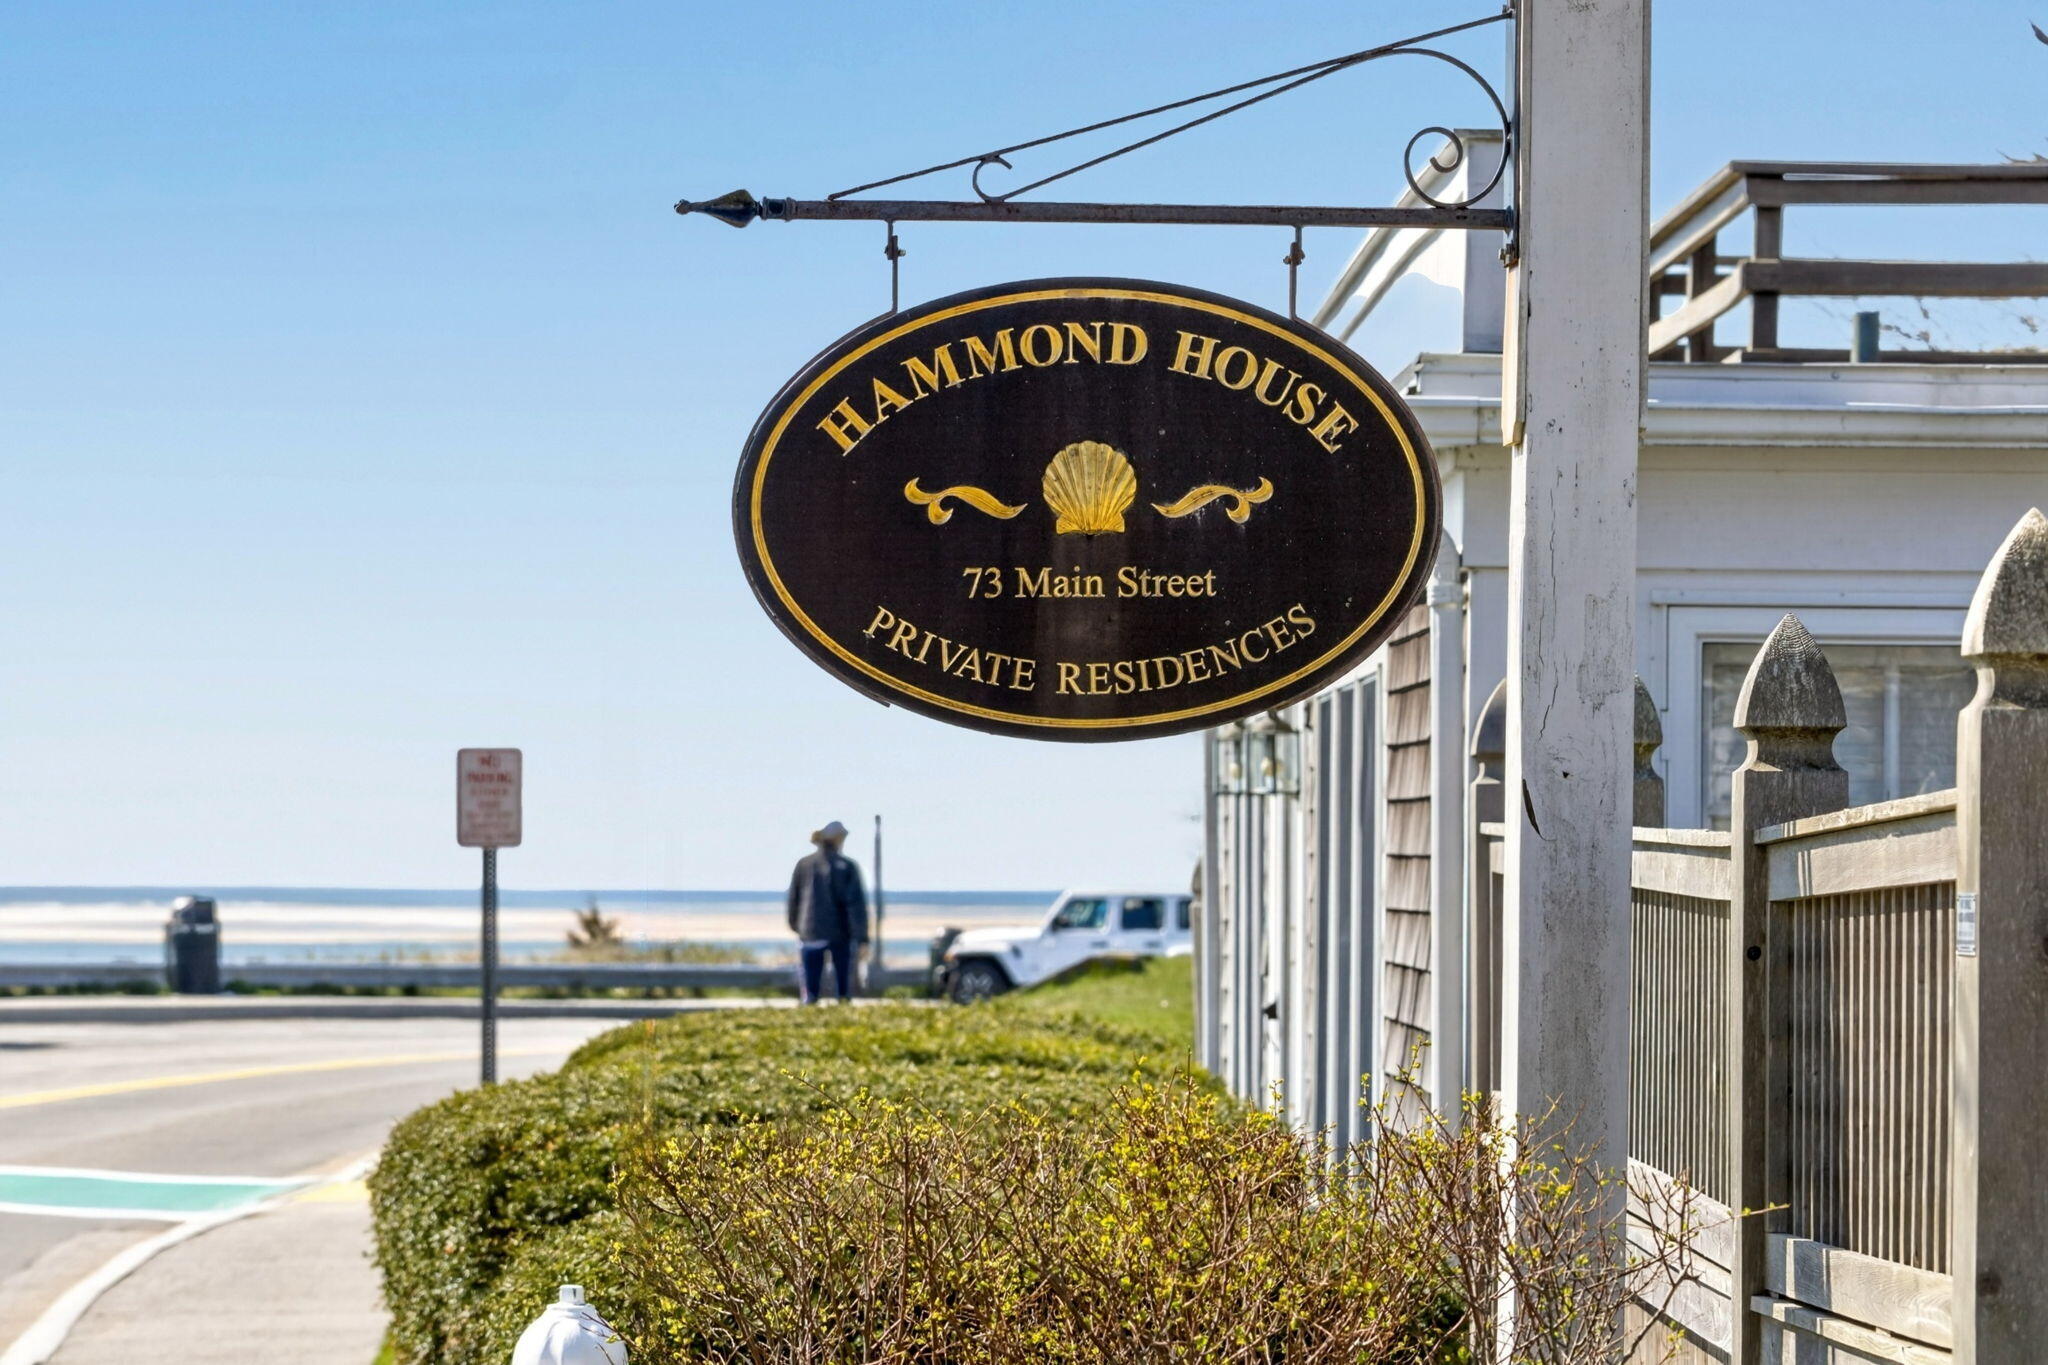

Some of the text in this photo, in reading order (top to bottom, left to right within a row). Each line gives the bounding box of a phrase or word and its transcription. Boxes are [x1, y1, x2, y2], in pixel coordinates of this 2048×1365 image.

[816, 321, 1359, 456] HAMMOND HOUSE
[962, 566, 1217, 598] 73 Main Street
[863, 603, 1317, 696] PRIVATE RESIDENCES
